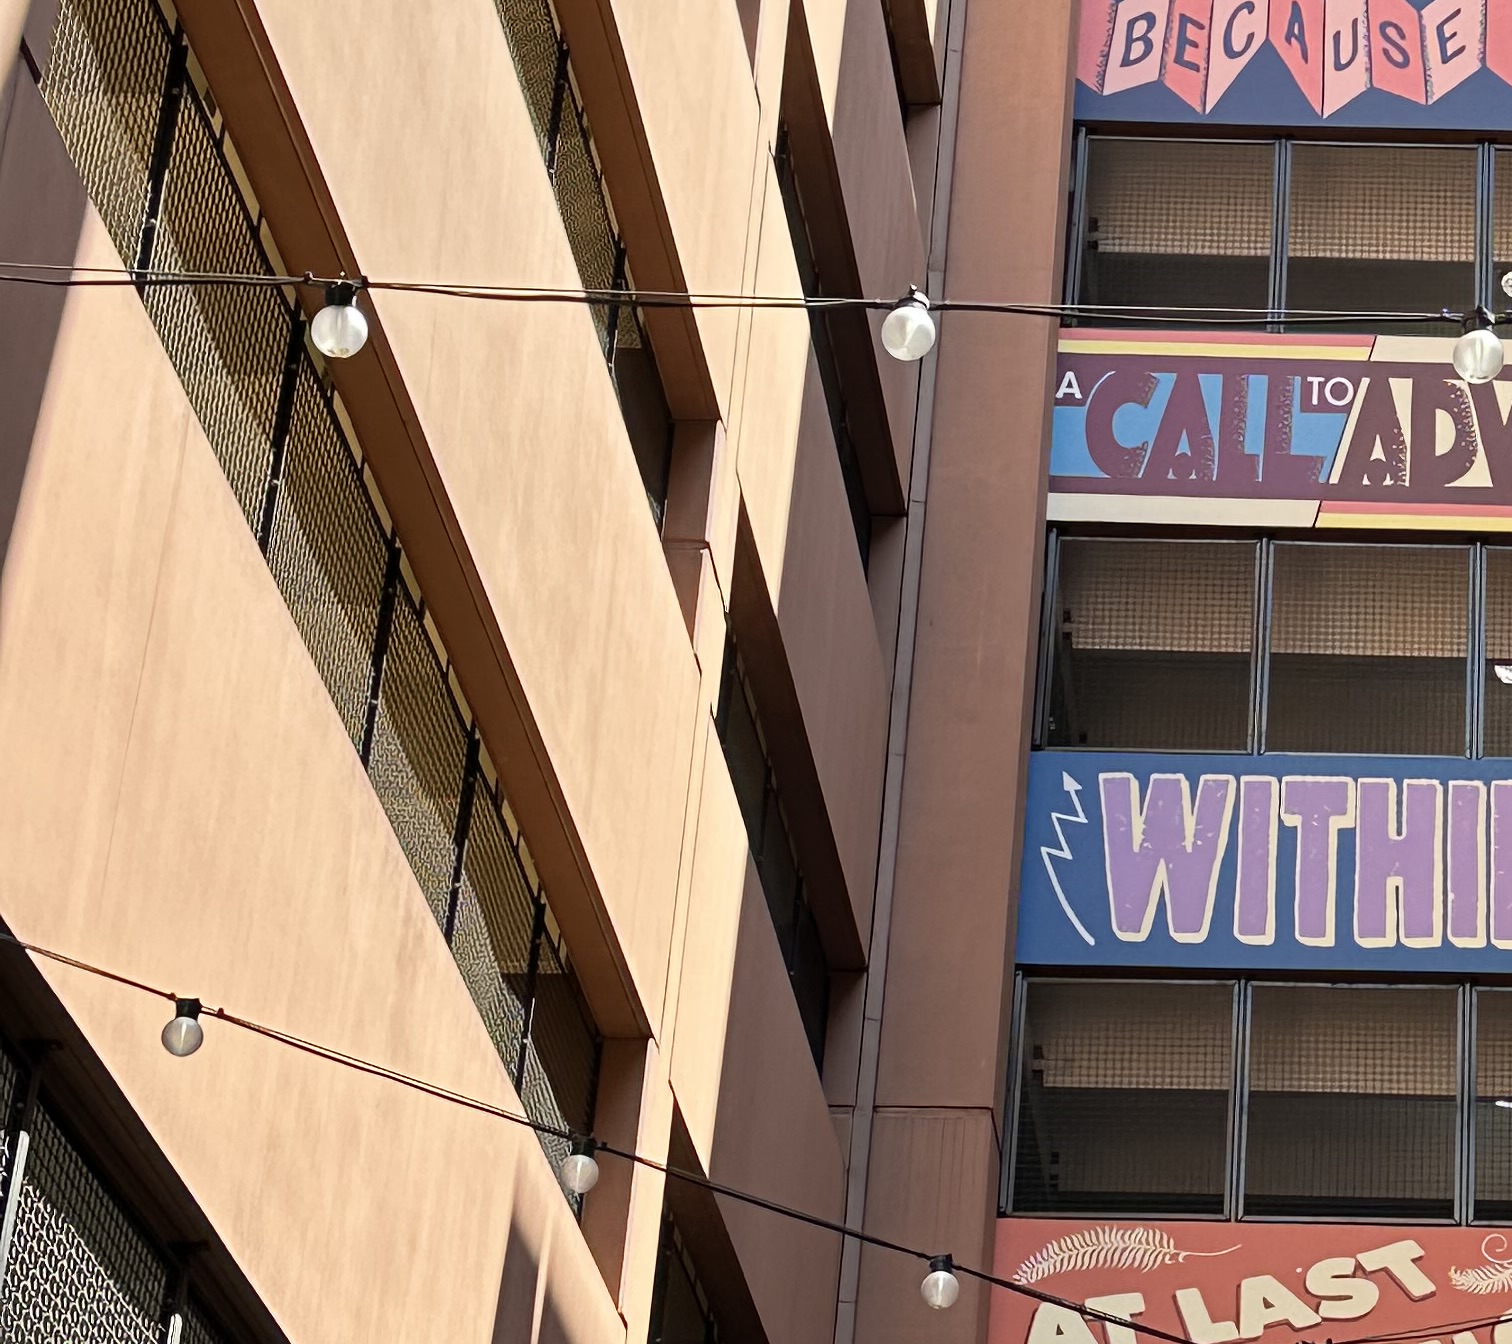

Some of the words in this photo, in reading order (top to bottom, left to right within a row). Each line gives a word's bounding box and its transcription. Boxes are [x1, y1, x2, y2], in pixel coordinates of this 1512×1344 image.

[1119, 0, 1467, 74] BECAUSE
[1055, 371, 1083, 399] A
[1084, 370, 1330, 484] CALL
[1307, 376, 1354, 406] TO
